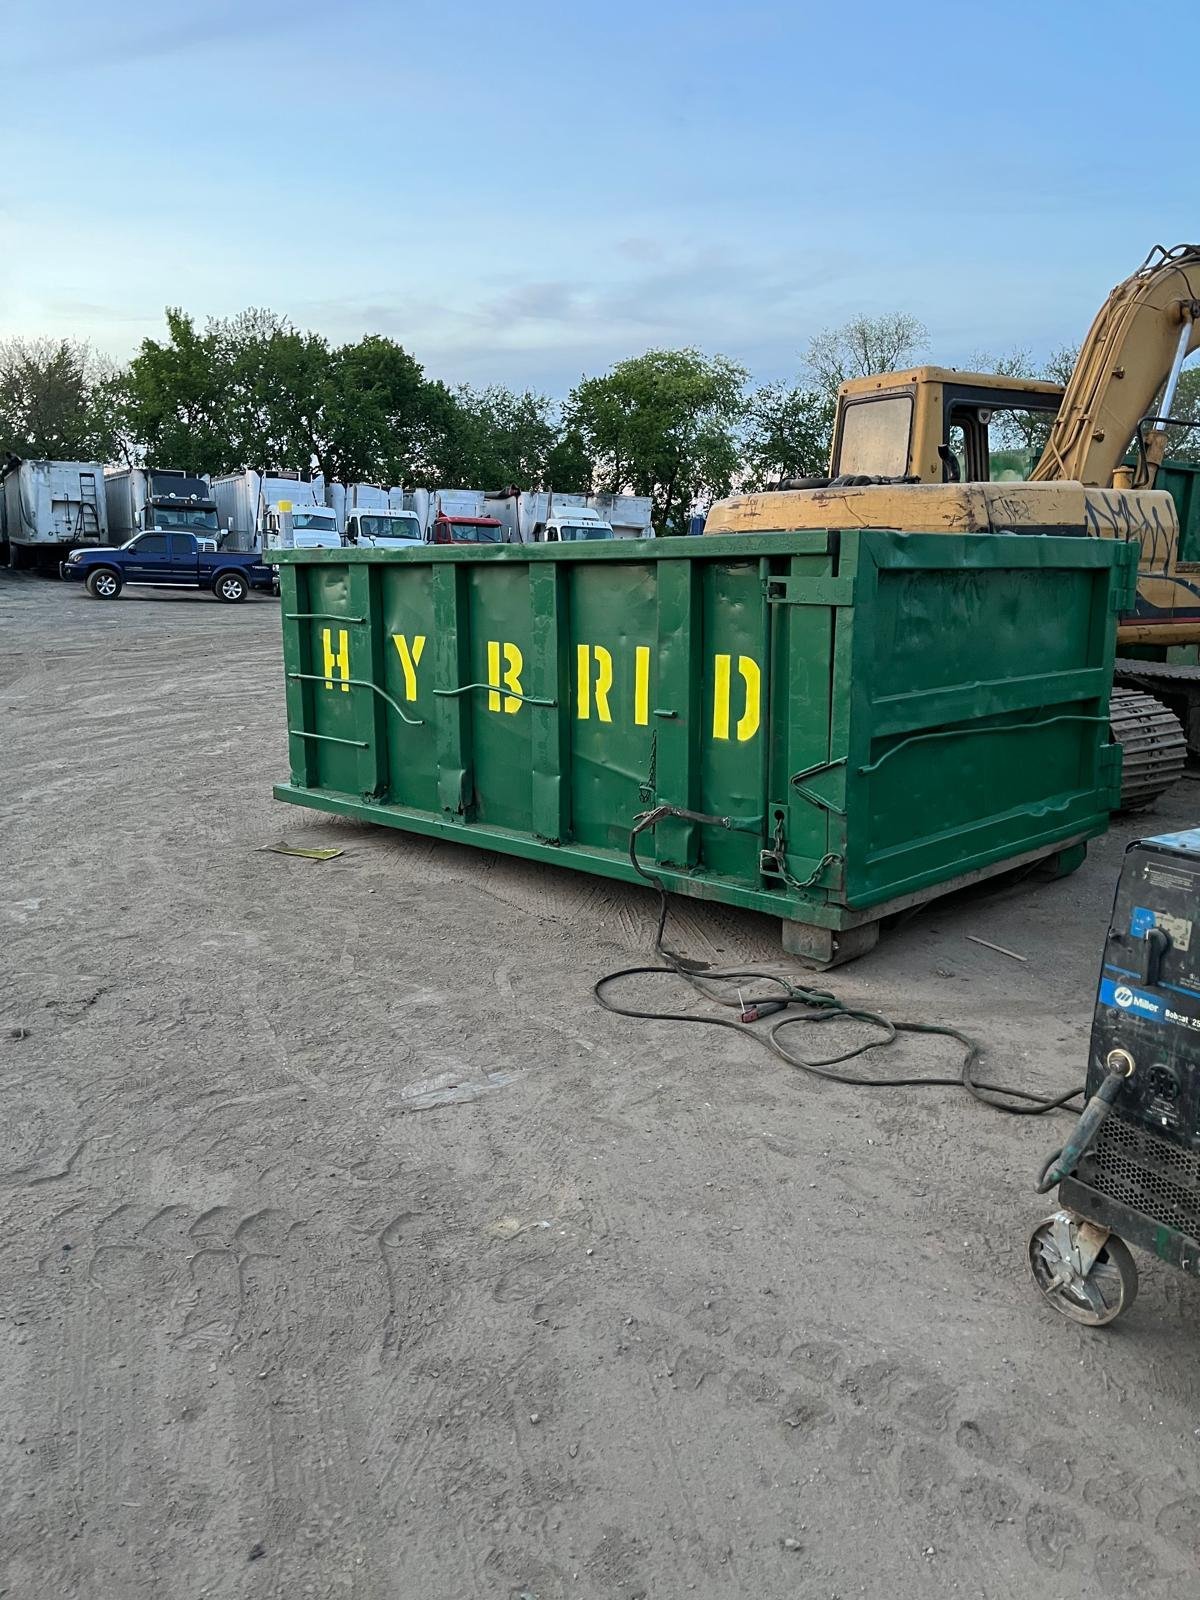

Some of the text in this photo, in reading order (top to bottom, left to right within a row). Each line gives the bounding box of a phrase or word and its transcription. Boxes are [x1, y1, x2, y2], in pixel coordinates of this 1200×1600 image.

[322, 629, 761, 741] HYBRID
[1133, 997, 1159, 1012] Miller
[1165, 1009, 1189, 1023] Bobcat
